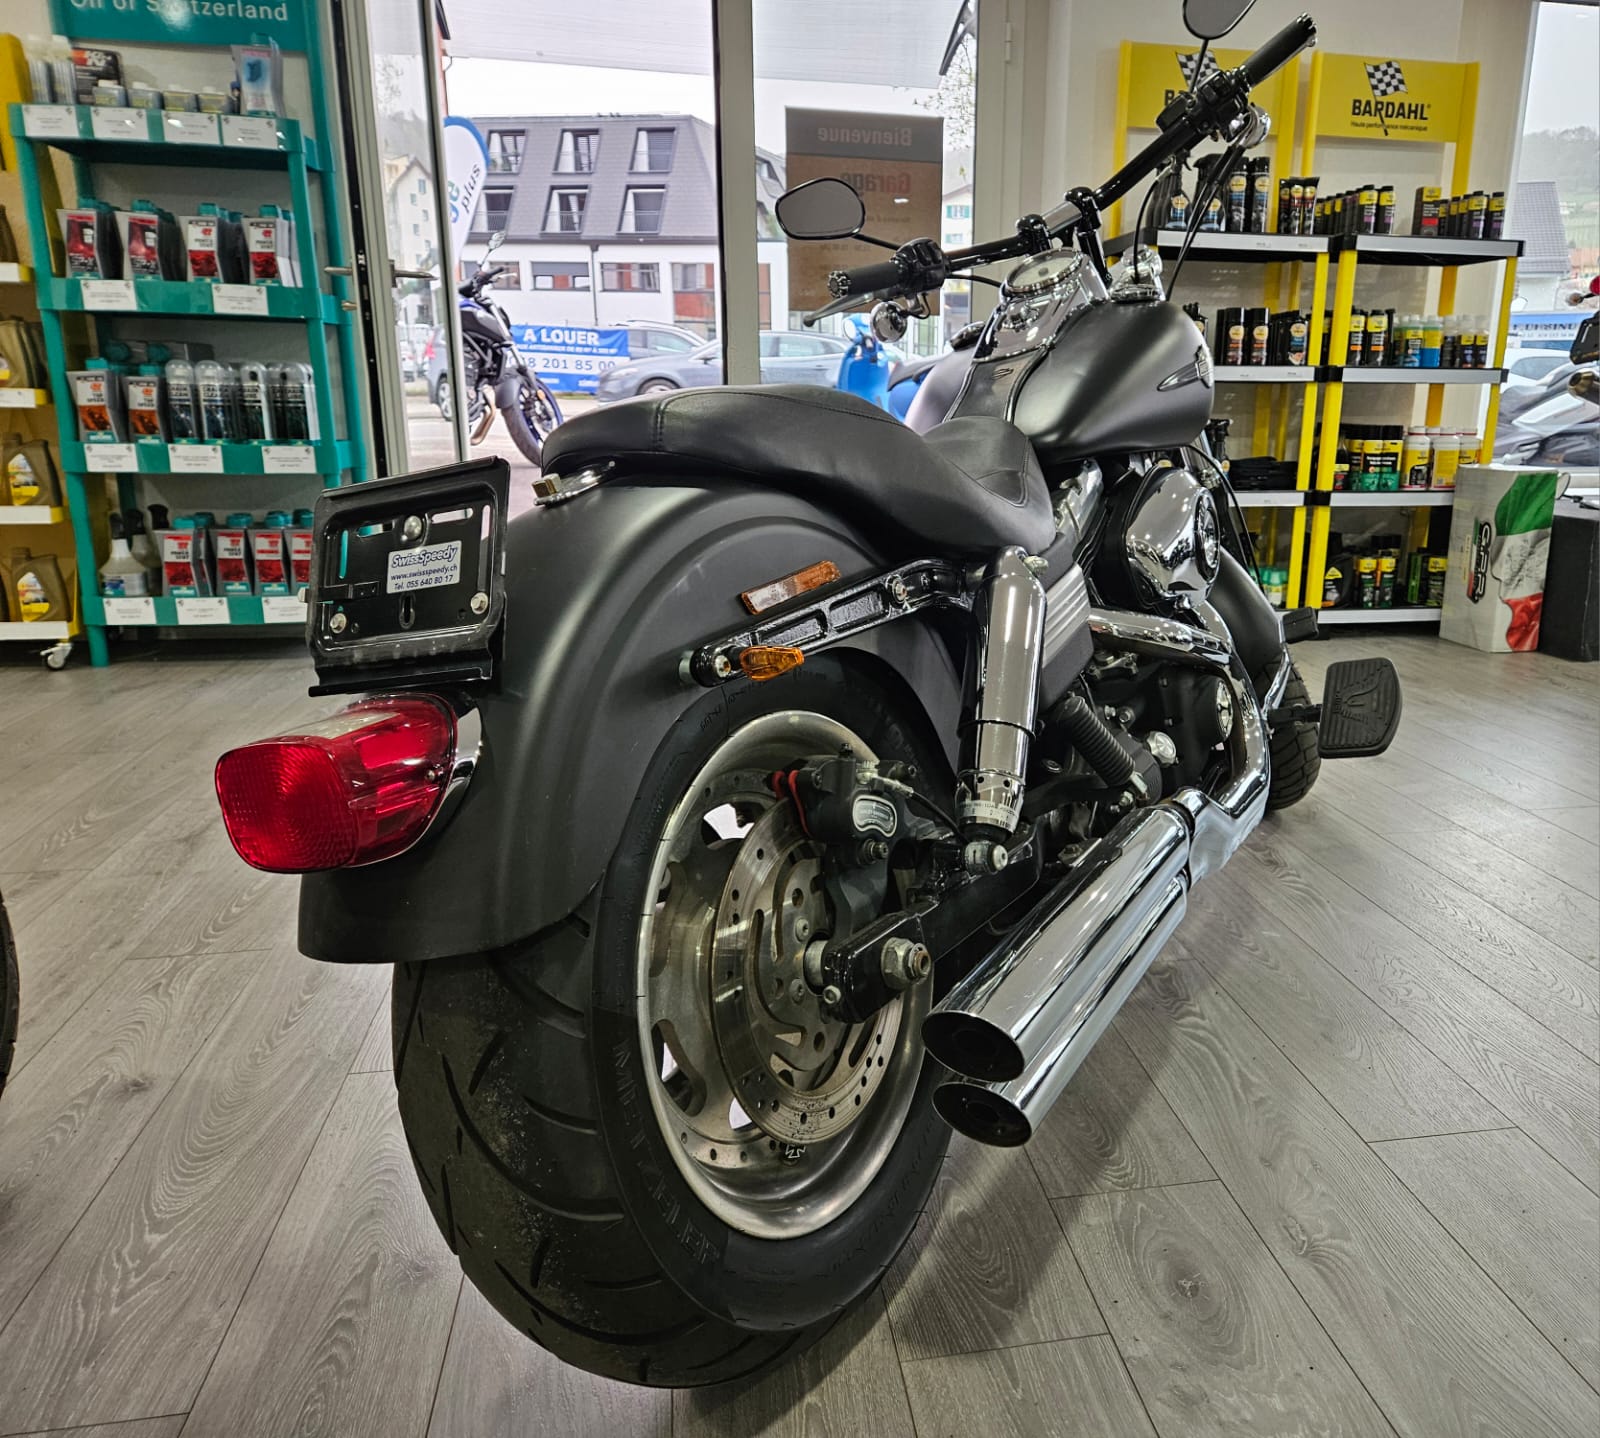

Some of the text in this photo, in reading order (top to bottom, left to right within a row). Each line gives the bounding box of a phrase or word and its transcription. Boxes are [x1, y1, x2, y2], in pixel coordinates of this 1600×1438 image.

[460, 163, 481, 214] plus
[540, 328, 600, 346] LOUER
[542, 358, 569, 369] 201
[575, 359, 593, 371] 85
[390, 544, 459, 569] SwissSpeedy
[390, 564, 458, 581] www.swissspeedy.ch
[406, 580, 419, 590] 055
[420, 579, 433, 588] 640
[444, 574, 454, 584] 17
